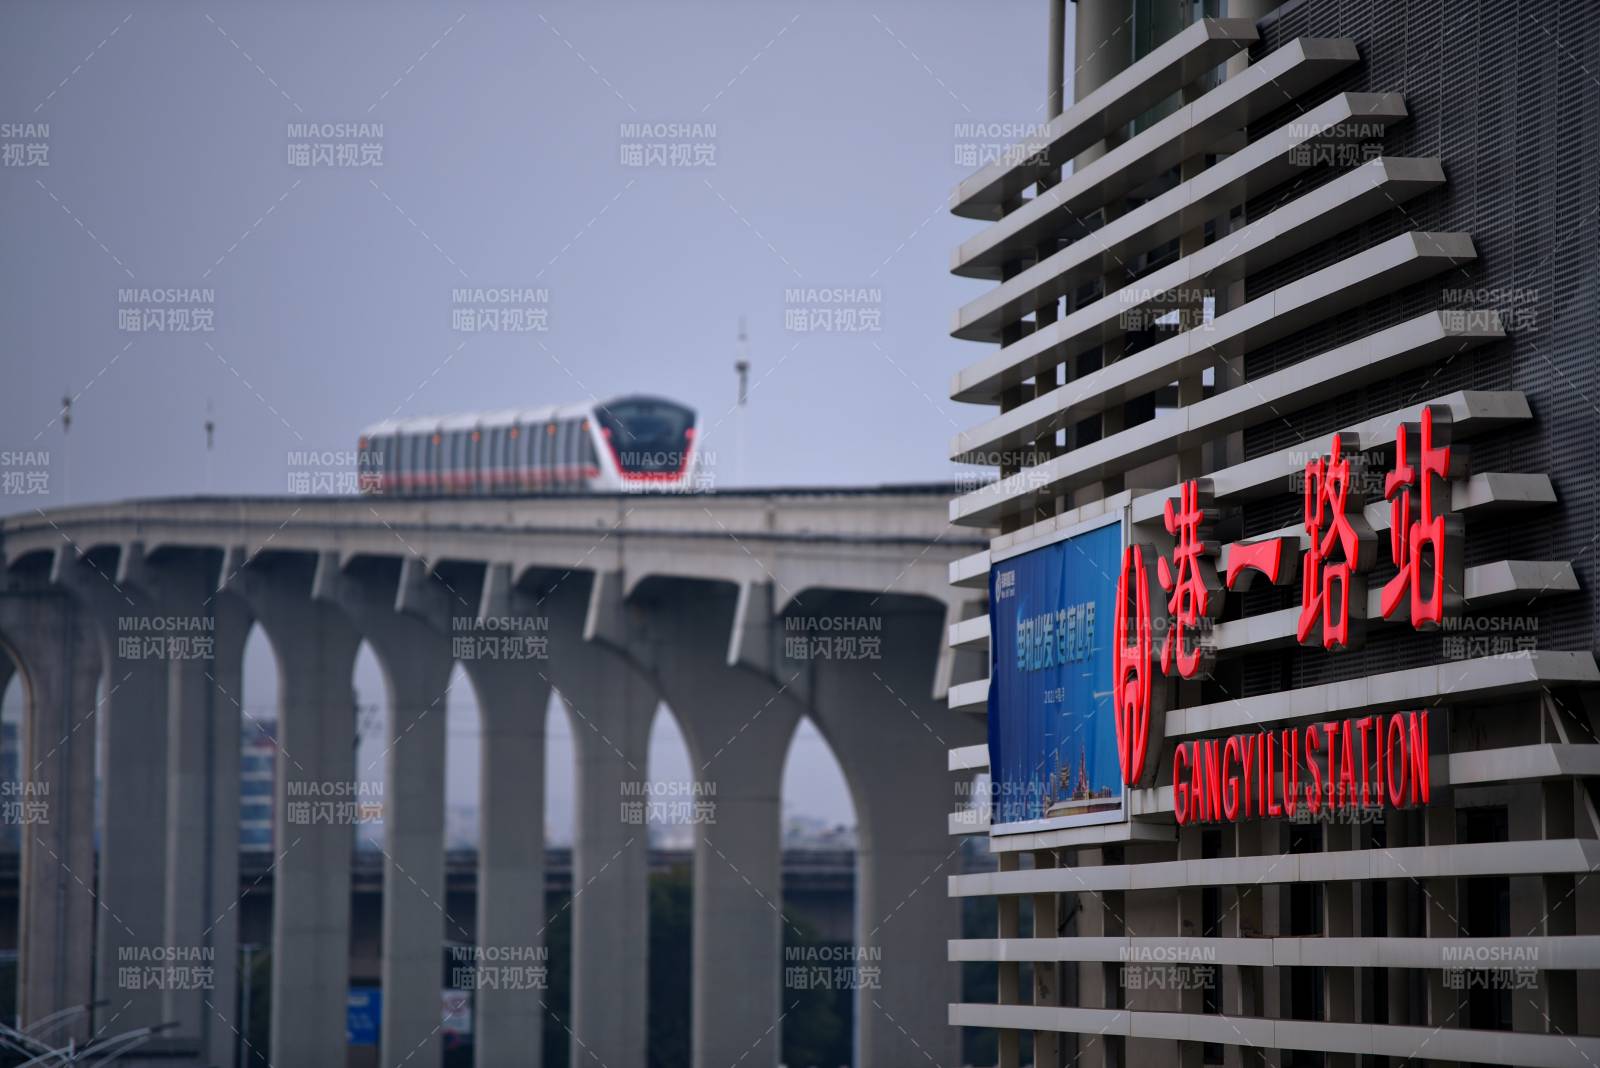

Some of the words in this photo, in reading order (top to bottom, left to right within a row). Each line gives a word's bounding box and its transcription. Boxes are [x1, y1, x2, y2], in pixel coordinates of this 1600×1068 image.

[1158, 407, 1450, 679] 港一路站
[1173, 727, 1298, 826] GANGYILU
[1305, 709, 1430, 811] STATION
